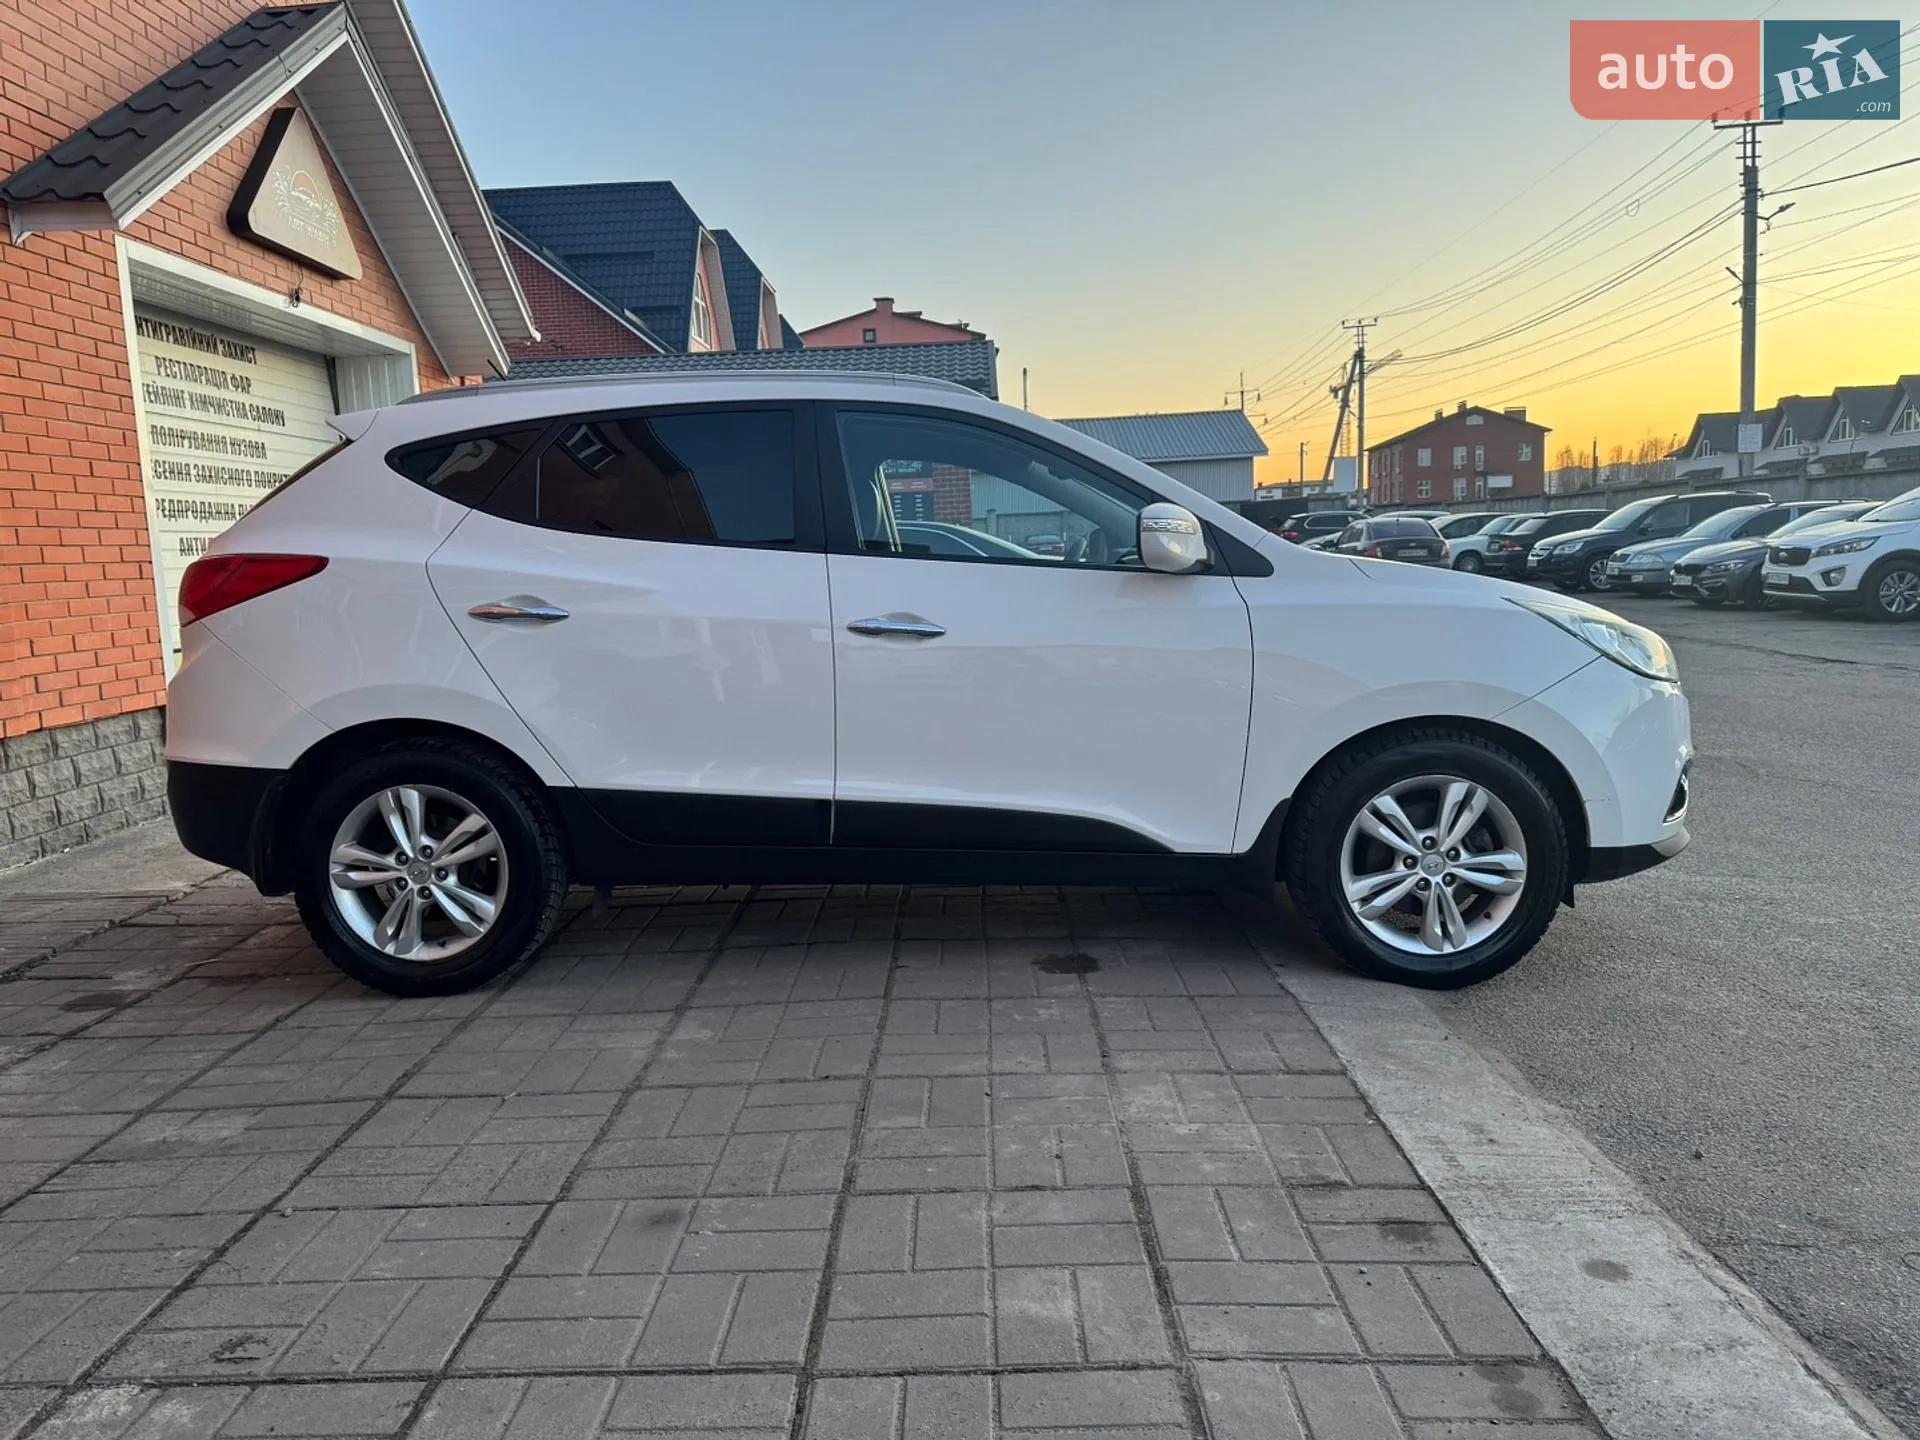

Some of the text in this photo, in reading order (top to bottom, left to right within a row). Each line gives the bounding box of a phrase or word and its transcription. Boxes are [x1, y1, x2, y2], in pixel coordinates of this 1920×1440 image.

[135, 315, 257, 365] НТИГРАВІЙНИЙ ЗАХИСТ
[154, 354, 252, 395] РЕСТАВРАЦІЯ ФАР
[187, 390, 250, 421] ХІМЧИСТКА
[249, 403, 286, 427] САЛОНУ
[150, 424, 268, 460] ПОЛІРУВАННЯ КУЗОВА
[150, 459, 291, 489] СЕННЯ ЗАХИСНОГО ПОКРИ
[178, 536, 208, 557] АНТИ
